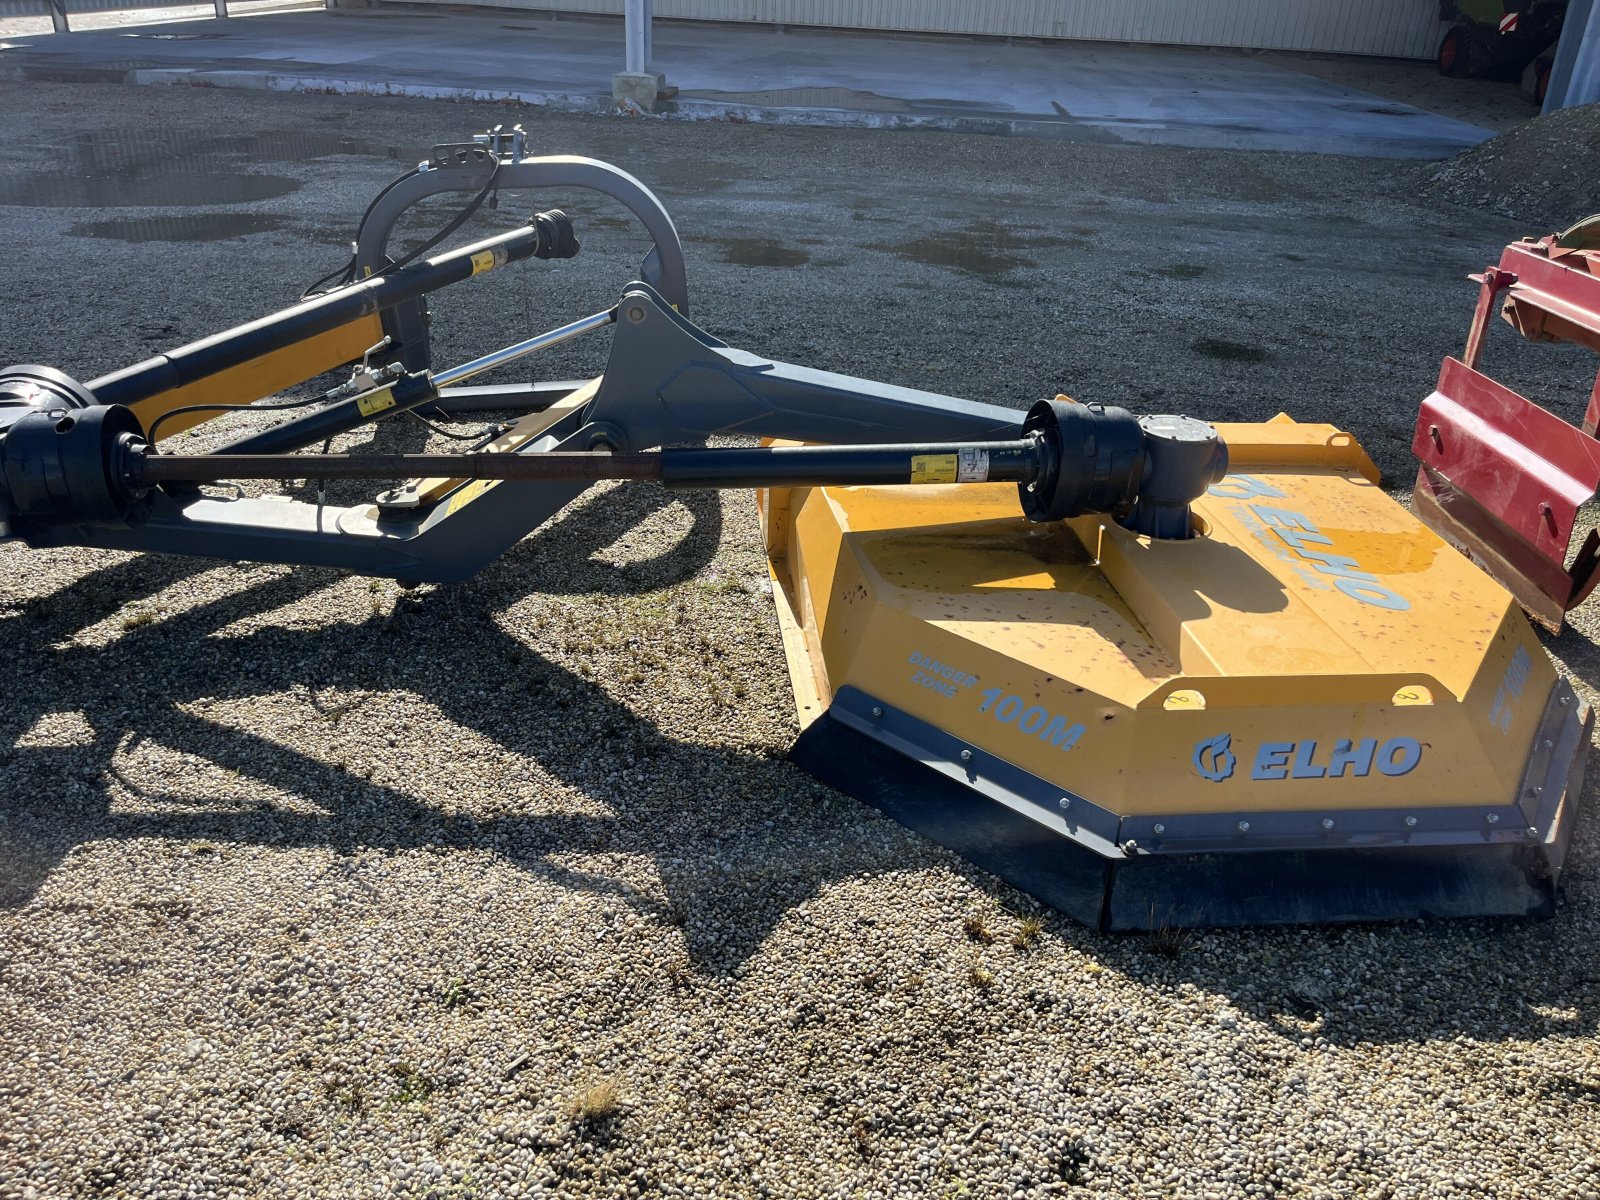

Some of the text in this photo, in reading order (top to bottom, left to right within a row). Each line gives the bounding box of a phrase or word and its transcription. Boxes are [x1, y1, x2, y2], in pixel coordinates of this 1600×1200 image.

[1248, 504, 1412, 611] ELHO
[908, 651, 978, 689] DANGER
[911, 671, 958, 698] ZONE
[978, 687, 1087, 752] 100M
[1251, 736, 1423, 781] ELHO
